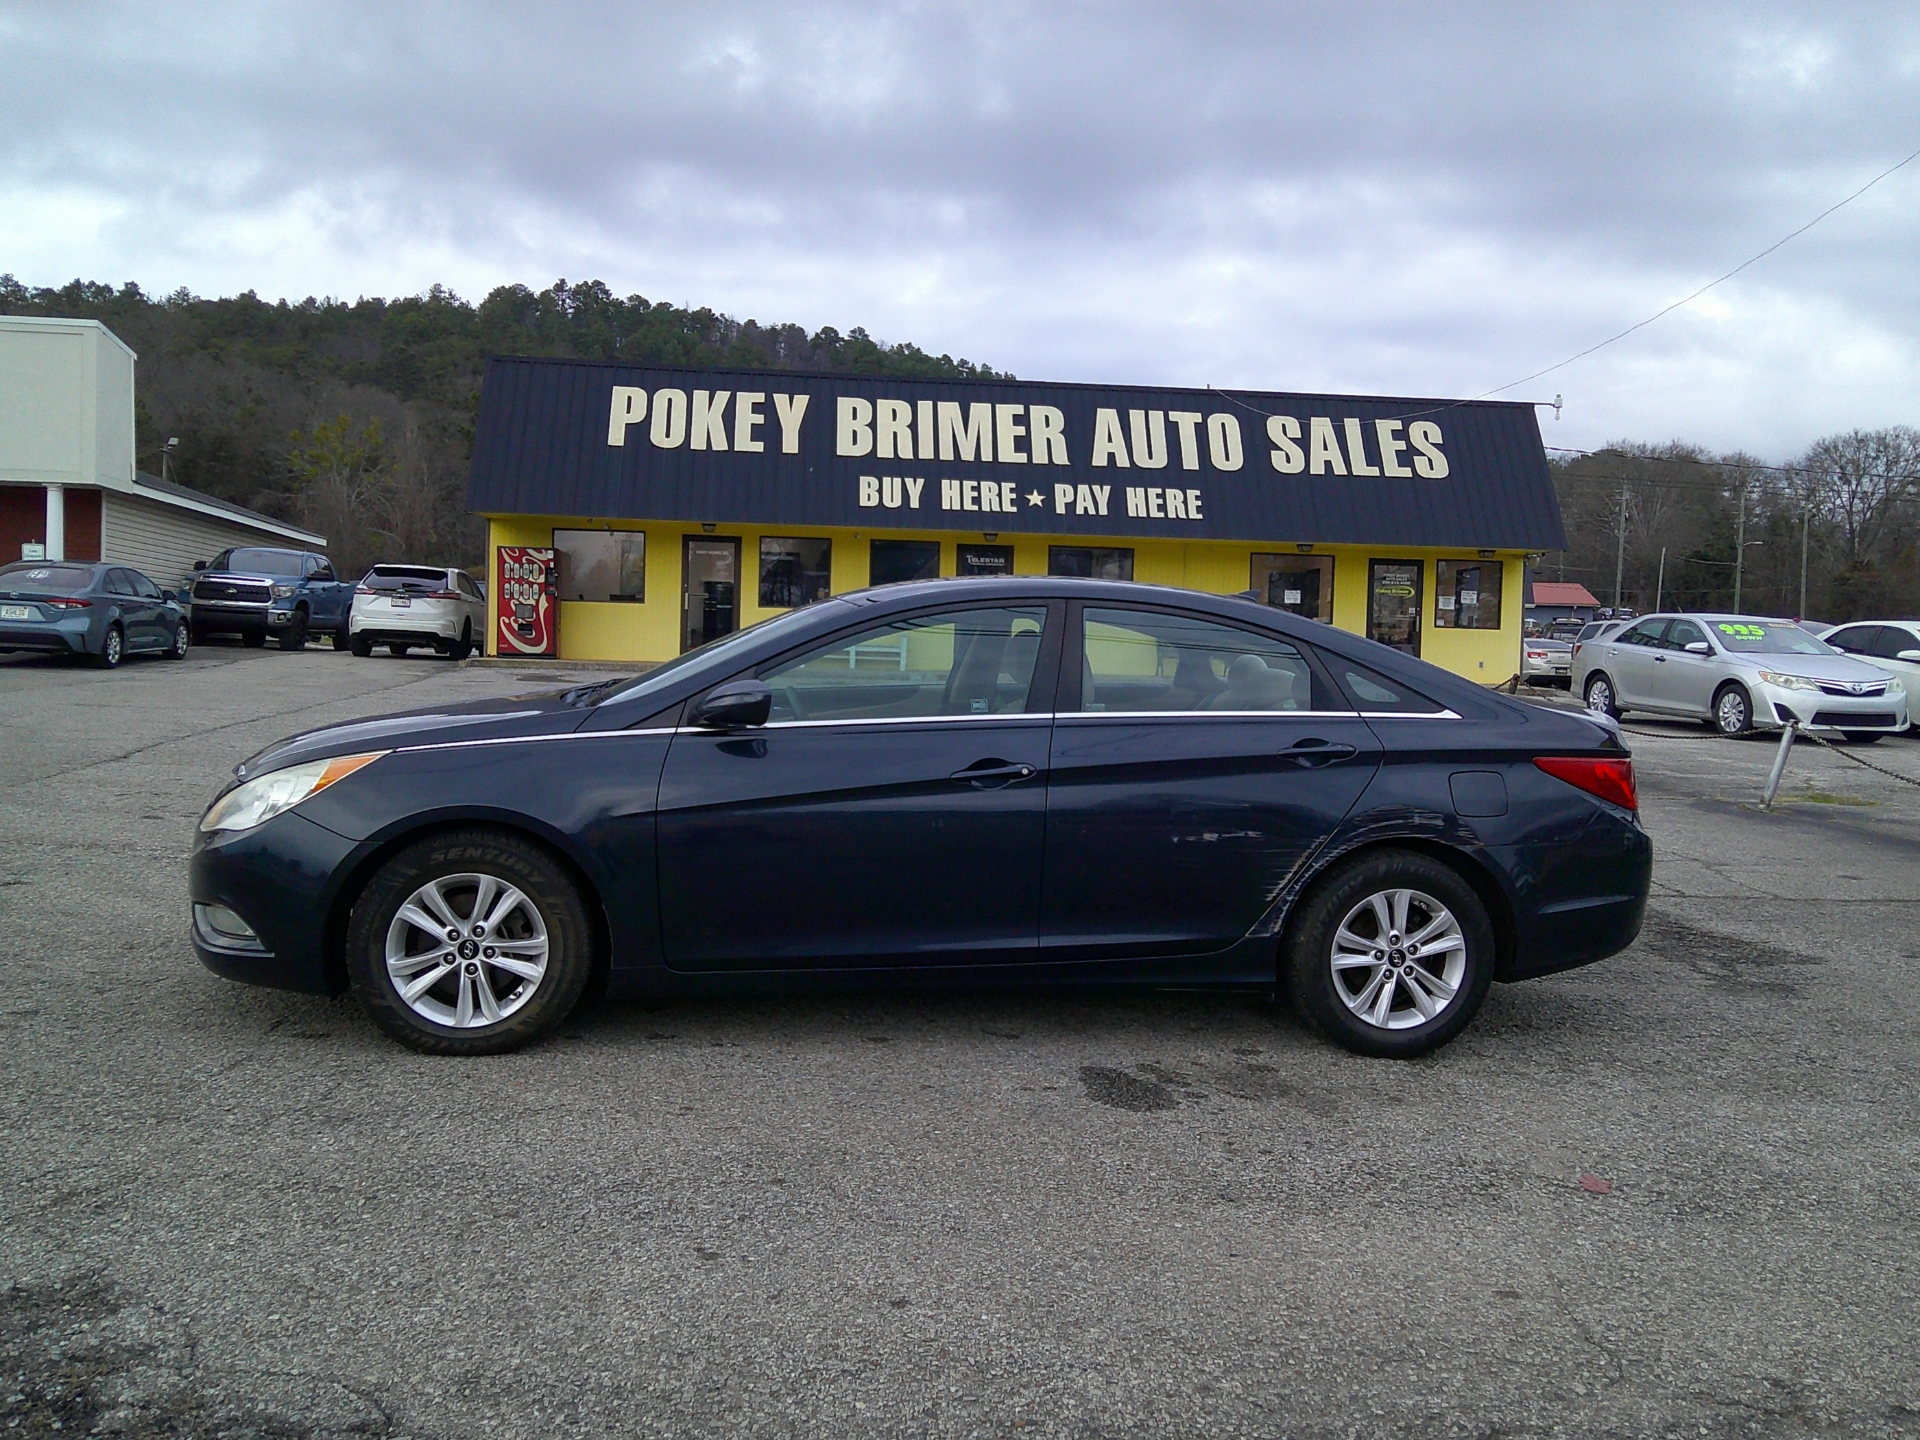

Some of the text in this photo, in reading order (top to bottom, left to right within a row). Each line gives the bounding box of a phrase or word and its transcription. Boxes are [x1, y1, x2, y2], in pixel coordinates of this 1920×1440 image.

[607, 385, 1450, 479] POKEY BRIMER AUTO SALES
[859, 475, 1203, 520] BUY HERE PAY HERE
[1719, 624, 1765, 635] 995
